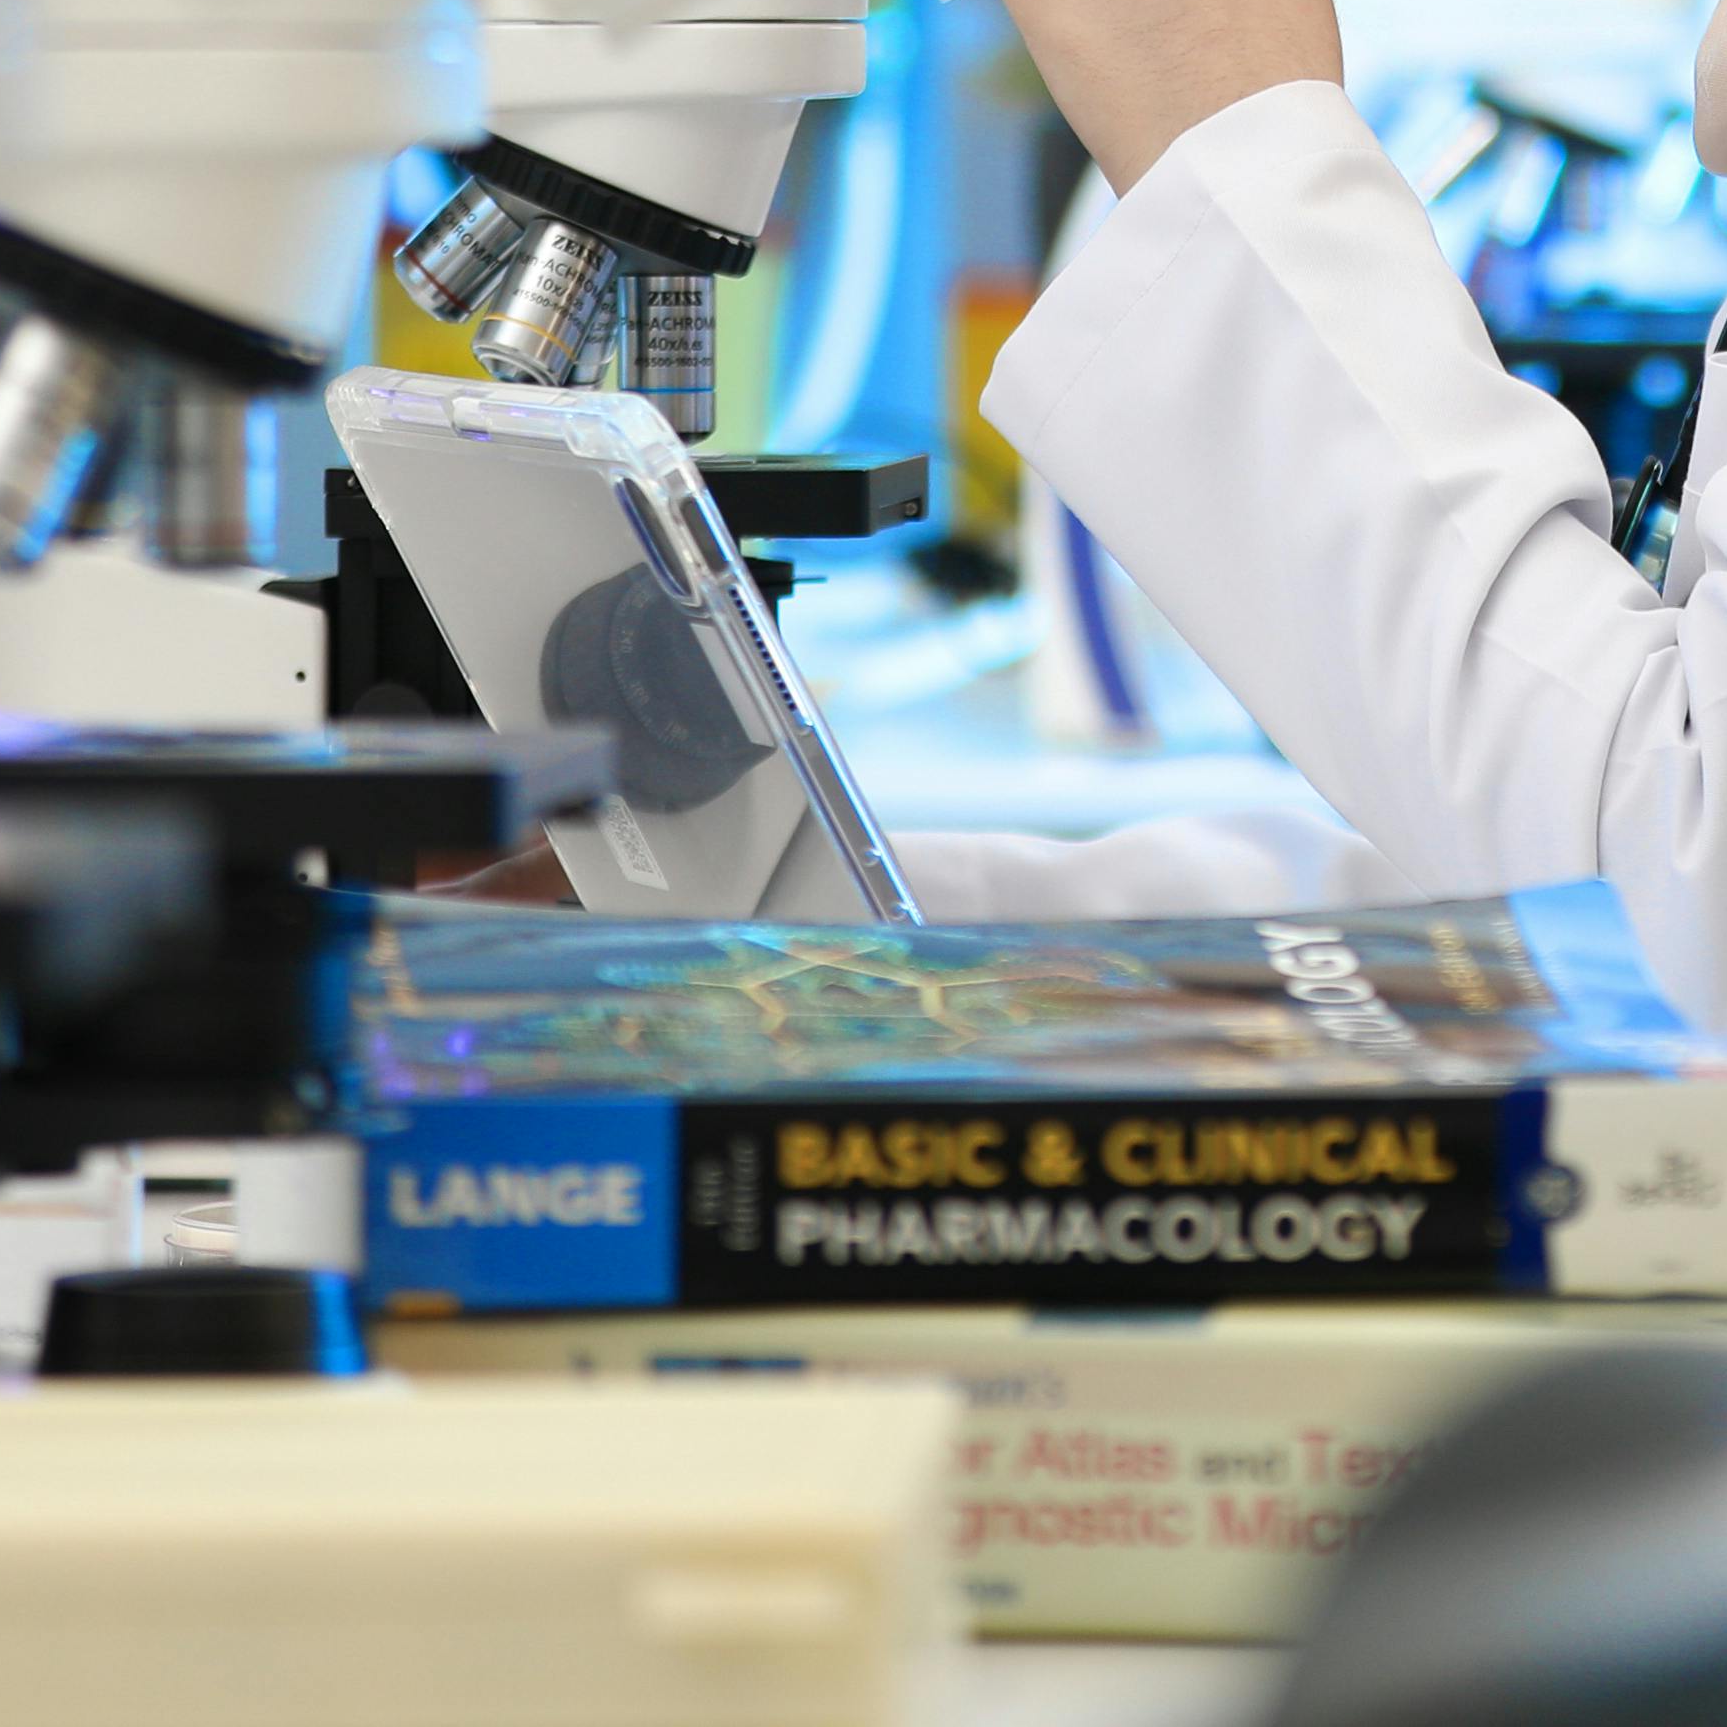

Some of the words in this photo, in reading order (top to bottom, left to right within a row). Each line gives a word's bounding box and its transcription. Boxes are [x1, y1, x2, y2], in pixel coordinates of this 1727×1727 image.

[551, 234, 605, 271] ZEISS
[647, 290, 703, 307] ZEISS
[776, 1119, 1007, 1190] BASIC
[1022, 1119, 1084, 1188] &
[1099, 1118, 1457, 1187] CLINICAL
[387, 1163, 644, 1228] LANGE
[776, 1195, 1429, 1265] PHARMACOLOGY
[951, 1493, 1190, 1559] gnostic
